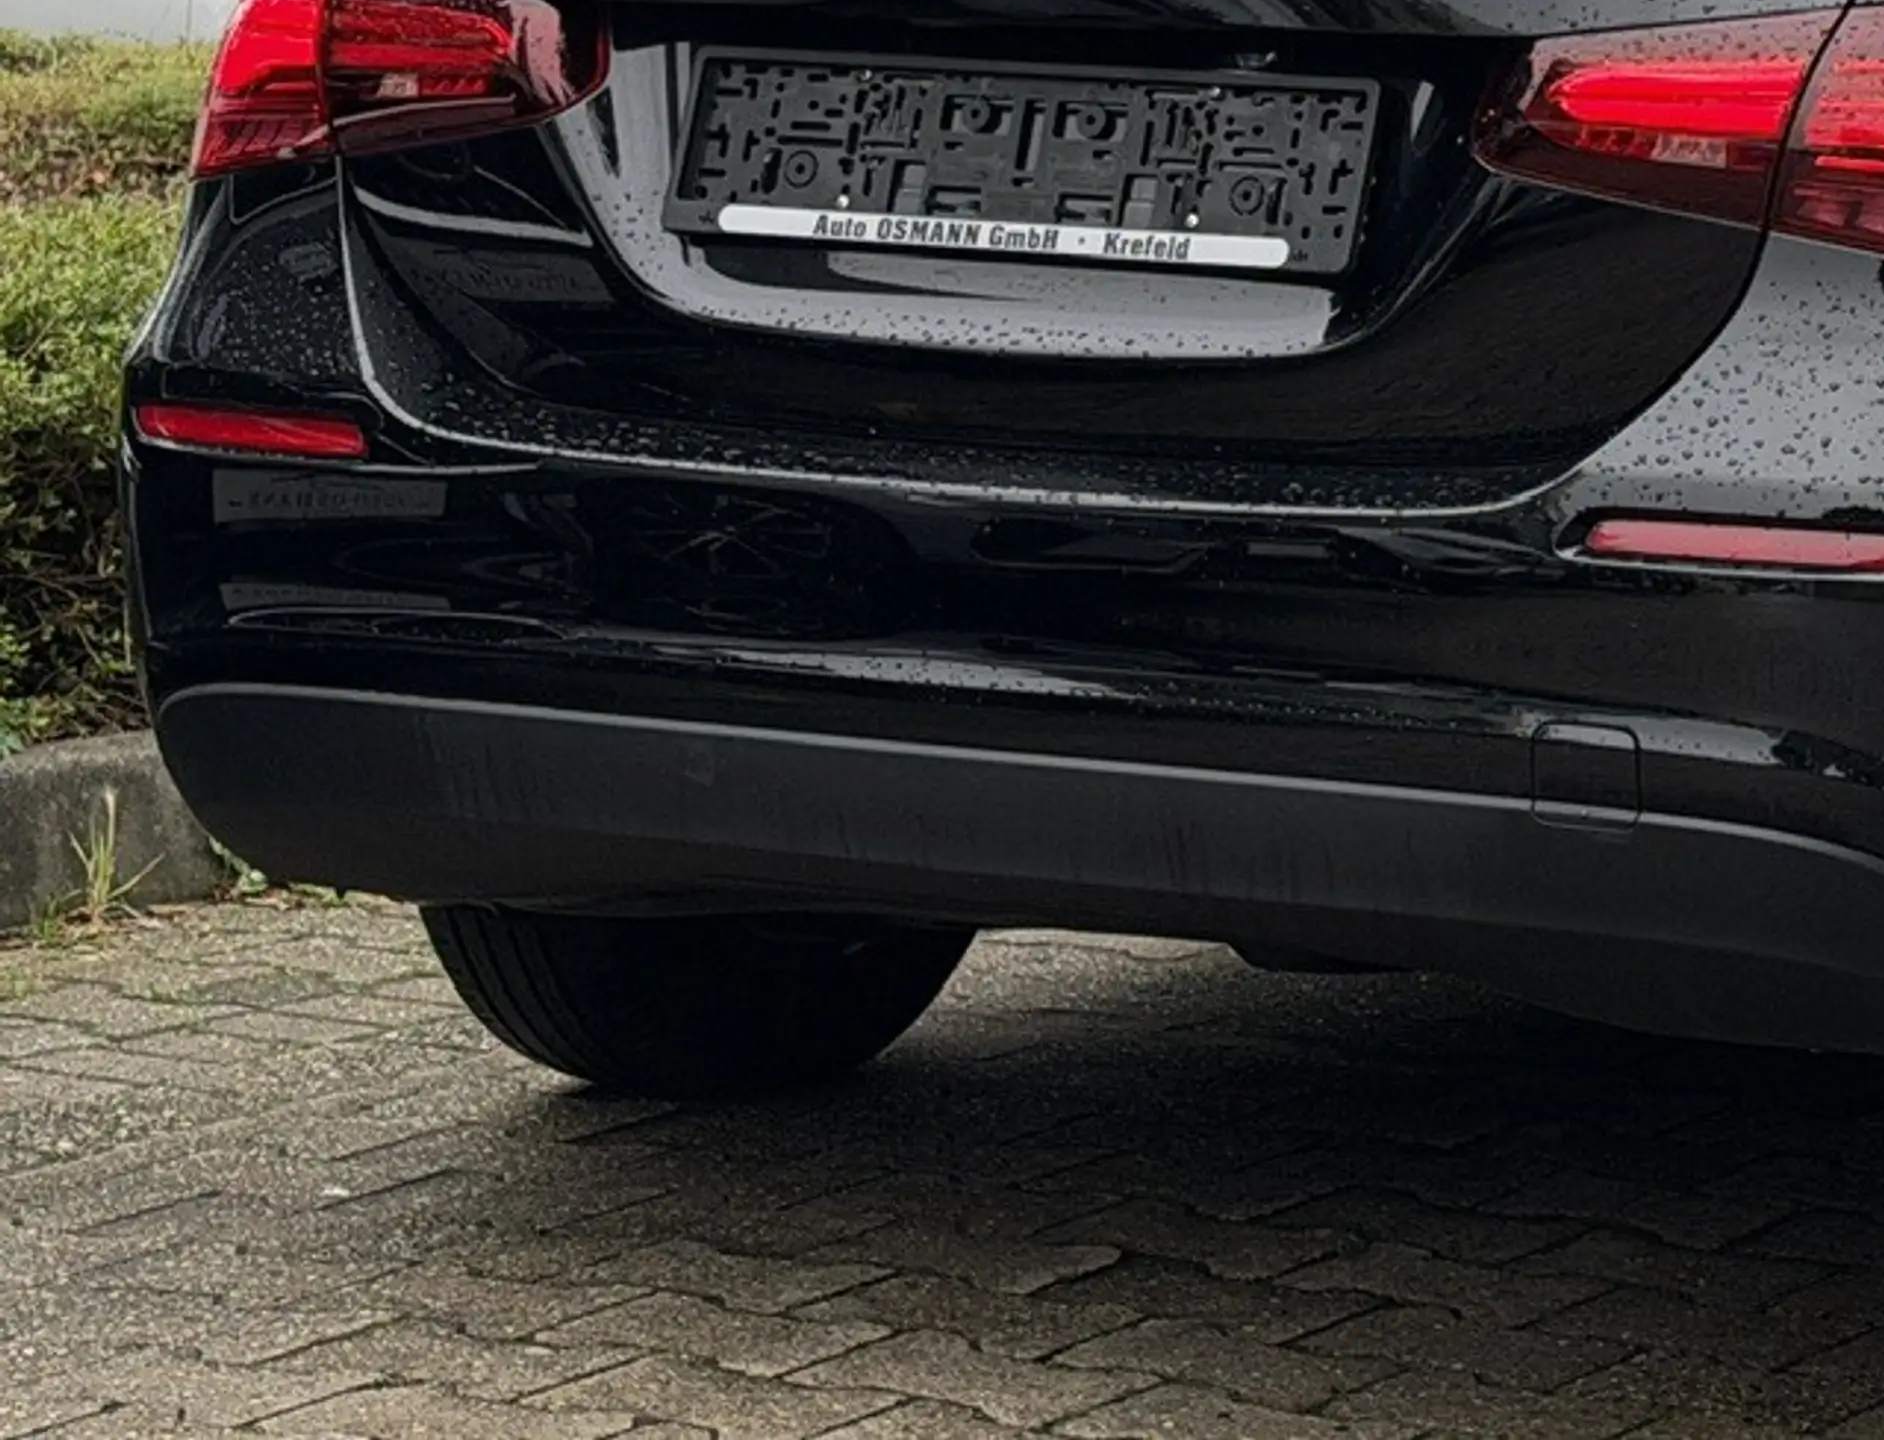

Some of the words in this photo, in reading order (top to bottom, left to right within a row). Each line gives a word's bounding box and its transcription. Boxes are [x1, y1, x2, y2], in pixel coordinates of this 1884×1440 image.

[813, 214, 868, 238] Auto
[877, 218, 982, 245] OSMANN
[988, 226, 1060, 250] GmbH
[1103, 232, 1191, 260] Krefeld
